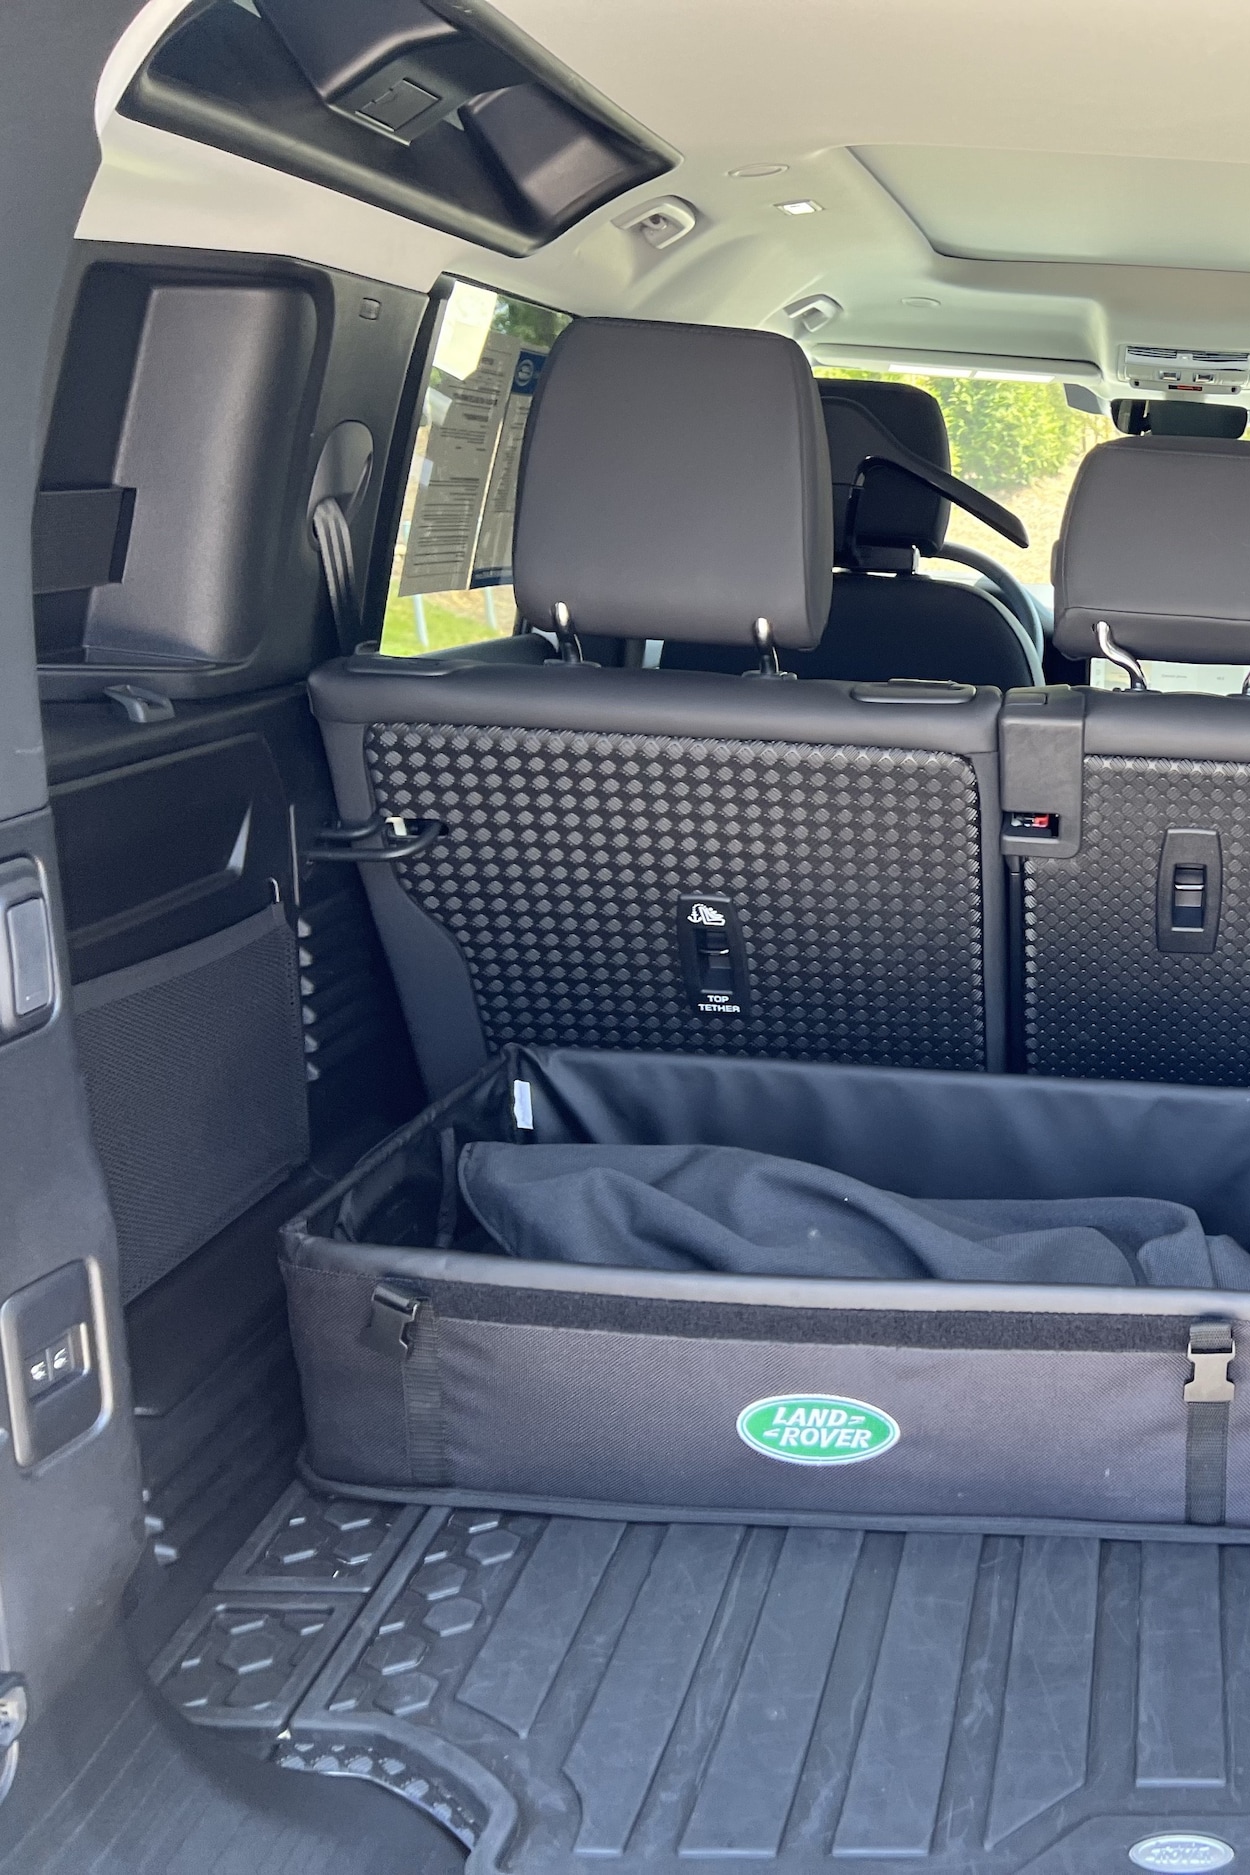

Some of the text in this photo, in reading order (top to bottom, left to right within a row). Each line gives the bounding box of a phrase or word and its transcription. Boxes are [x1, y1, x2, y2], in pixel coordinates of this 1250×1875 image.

[707, 995, 730, 1003] TOP
[698, 1003, 741, 1013] TETHER
[772, 1407, 848, 1427] LAND
[779, 1427, 872, 1449] ROVER
